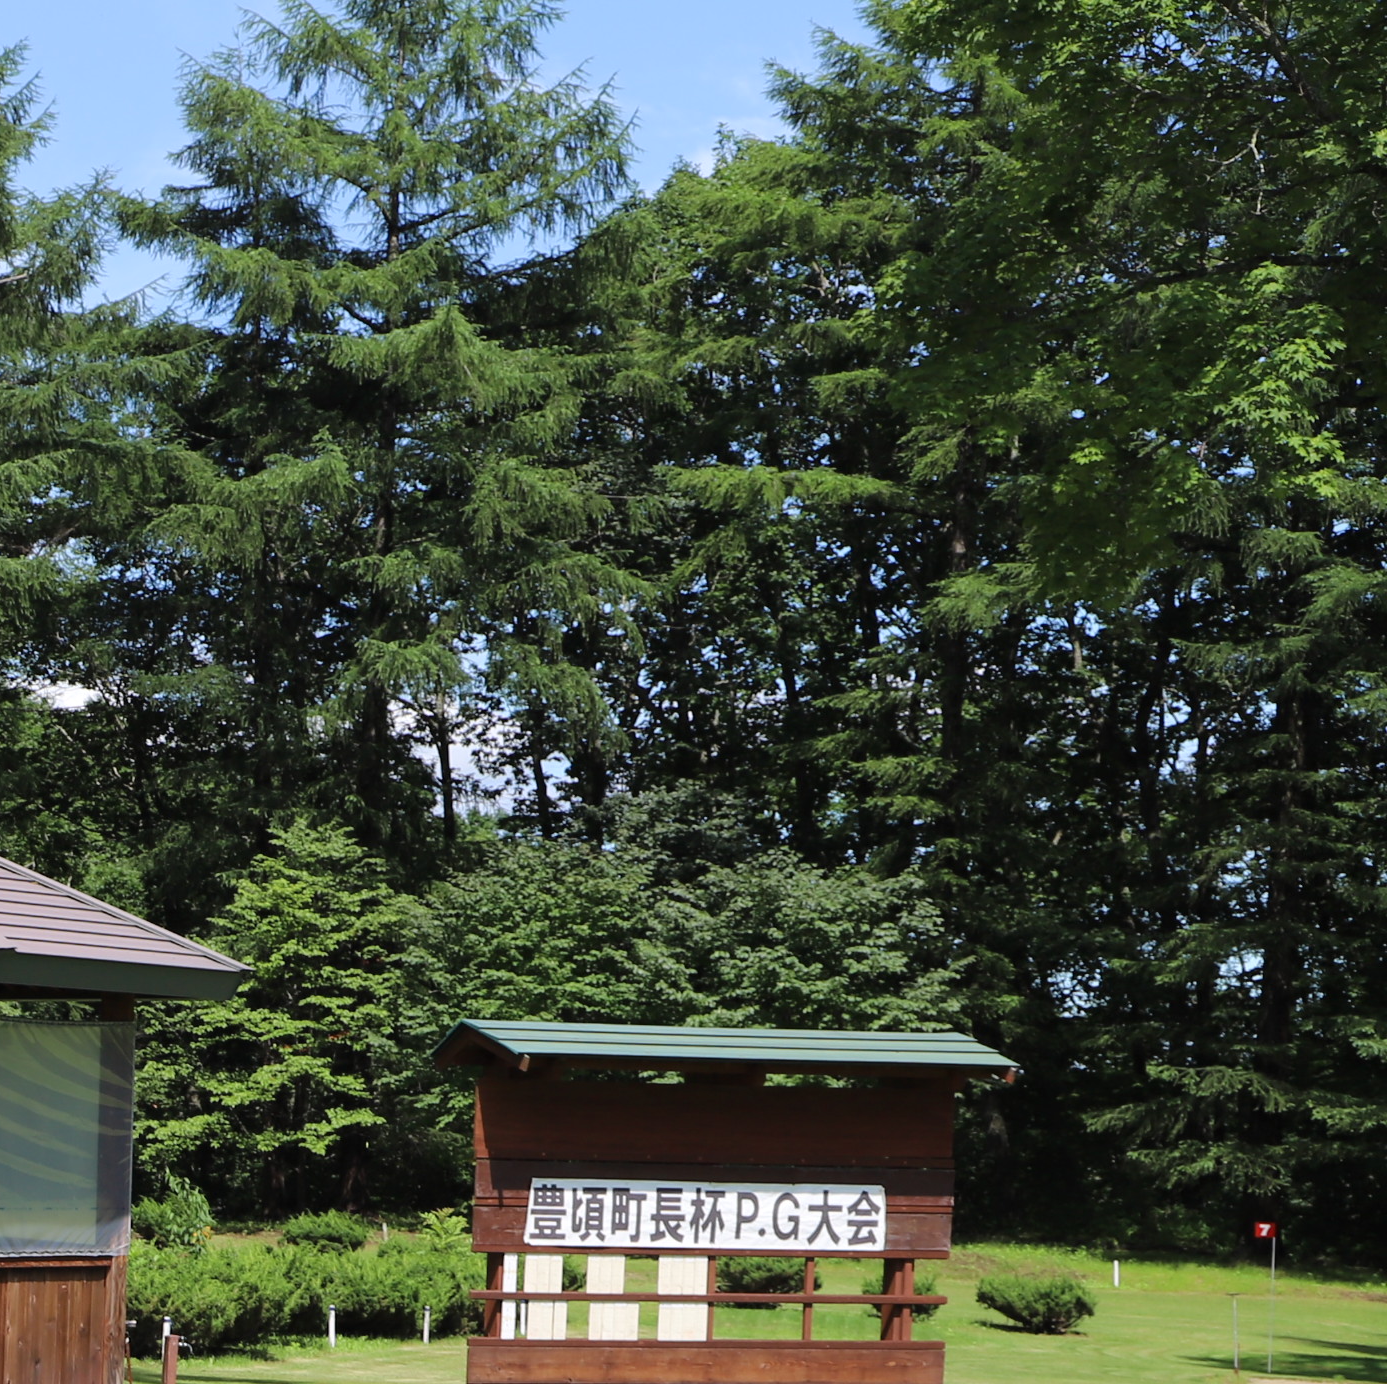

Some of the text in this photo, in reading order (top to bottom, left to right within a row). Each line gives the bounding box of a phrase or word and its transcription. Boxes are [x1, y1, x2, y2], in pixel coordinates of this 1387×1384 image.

[529, 1184, 881, 1246] 豊頃町長杯P.G大会
[1259, 1224, 1271, 1236] 7
